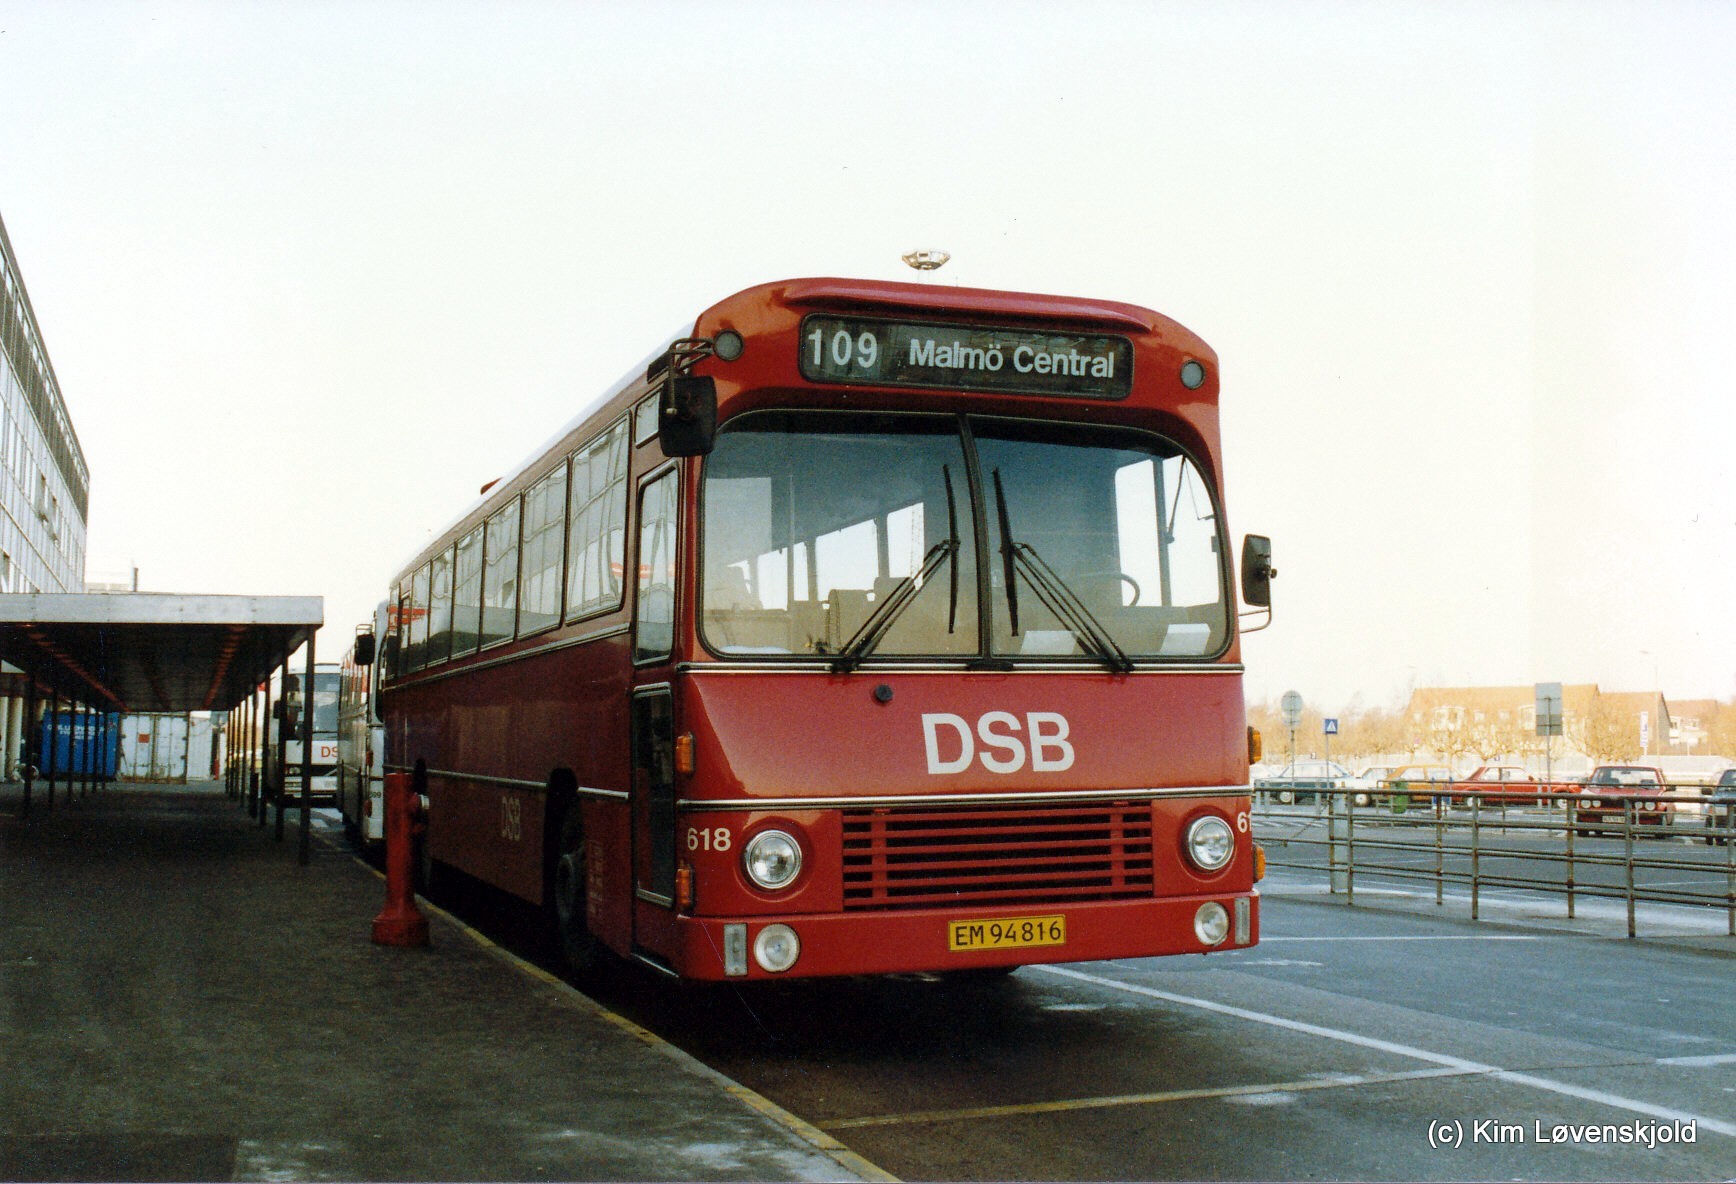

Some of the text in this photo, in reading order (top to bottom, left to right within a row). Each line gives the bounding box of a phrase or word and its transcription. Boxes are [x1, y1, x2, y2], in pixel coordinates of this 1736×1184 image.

[808, 328, 878, 369] 109
[909, 339, 1115, 379] Malmö Central
[921, 711, 1075, 774] DSB
[687, 827, 731, 851] 618
